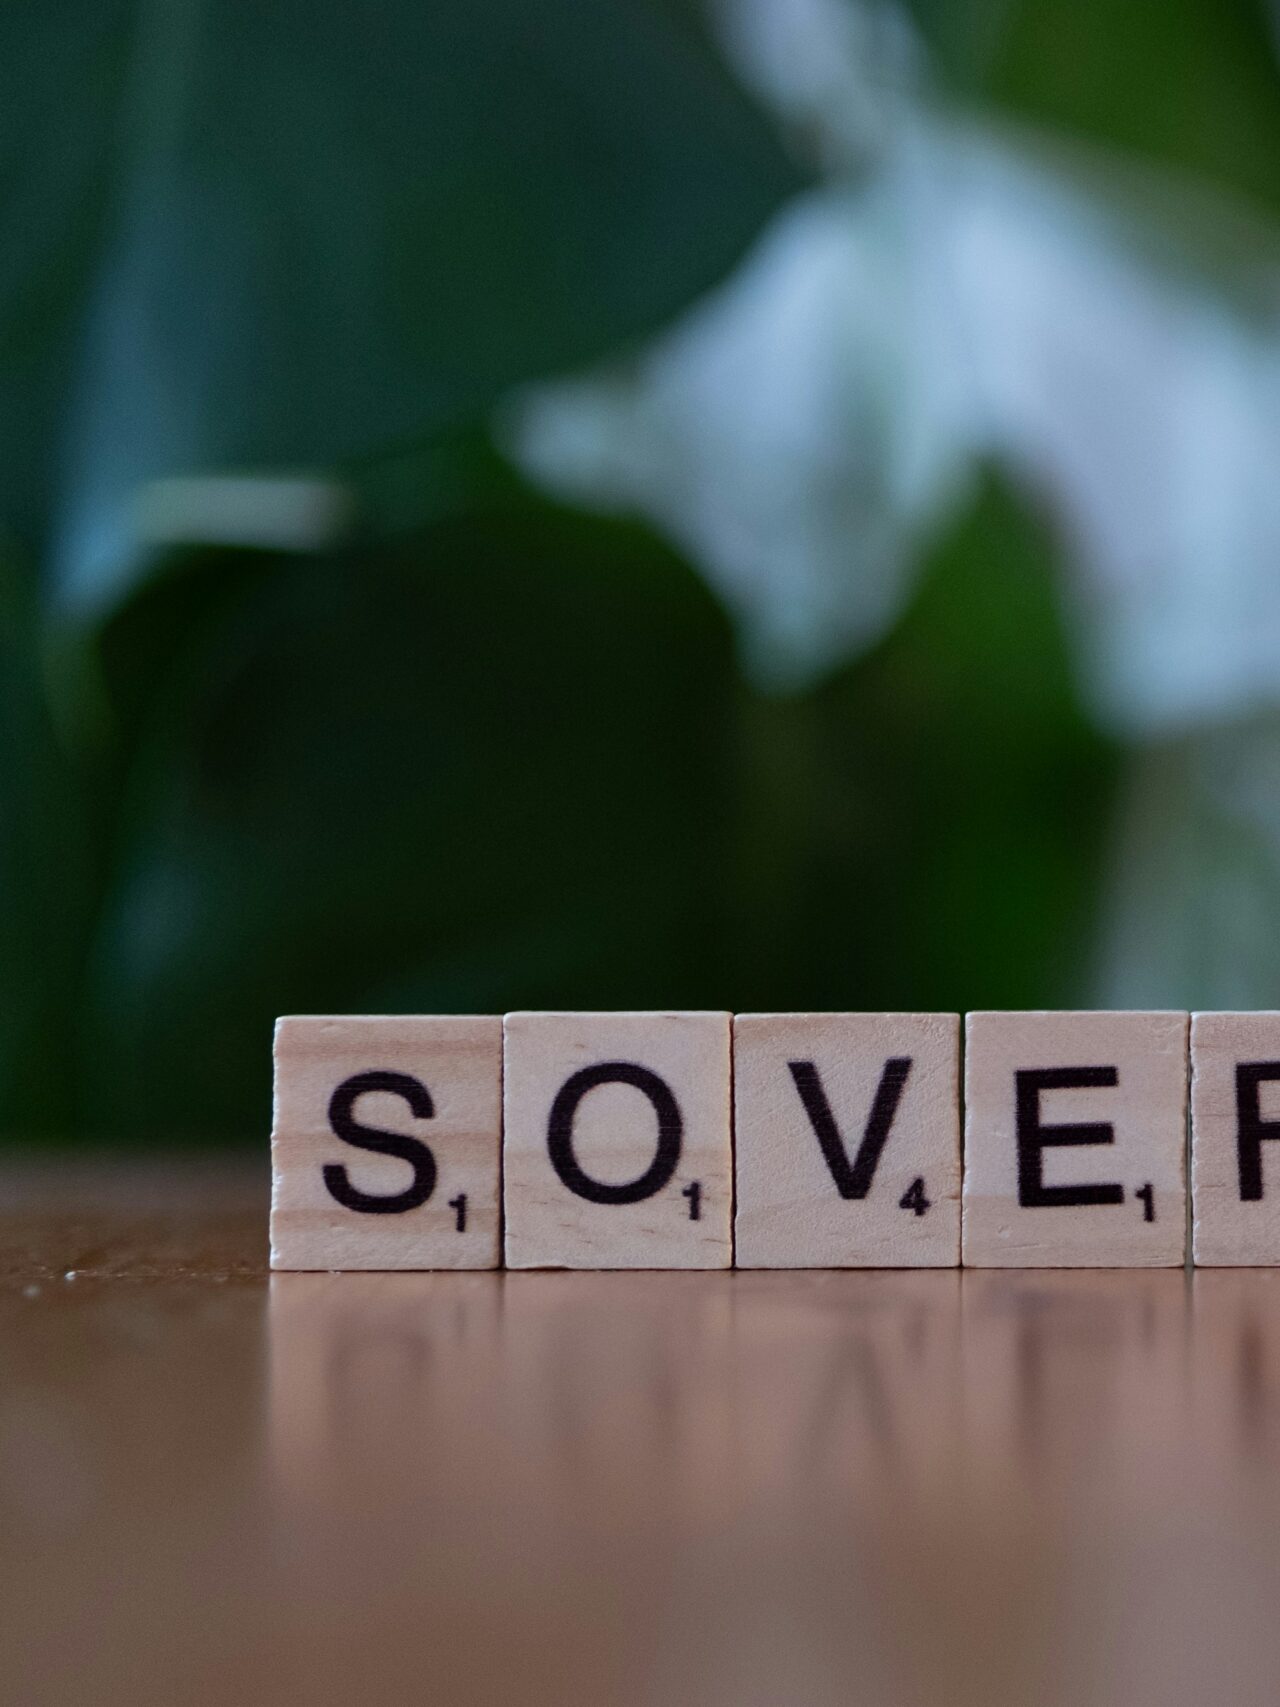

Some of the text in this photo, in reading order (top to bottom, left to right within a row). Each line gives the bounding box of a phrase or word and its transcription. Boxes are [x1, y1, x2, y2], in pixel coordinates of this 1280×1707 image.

[447, 1193, 469, 1234] 1
[681, 1181, 702, 1221] 1
[898, 1176, 932, 1217] 4
[1134, 1183, 1156, 1223] 1
